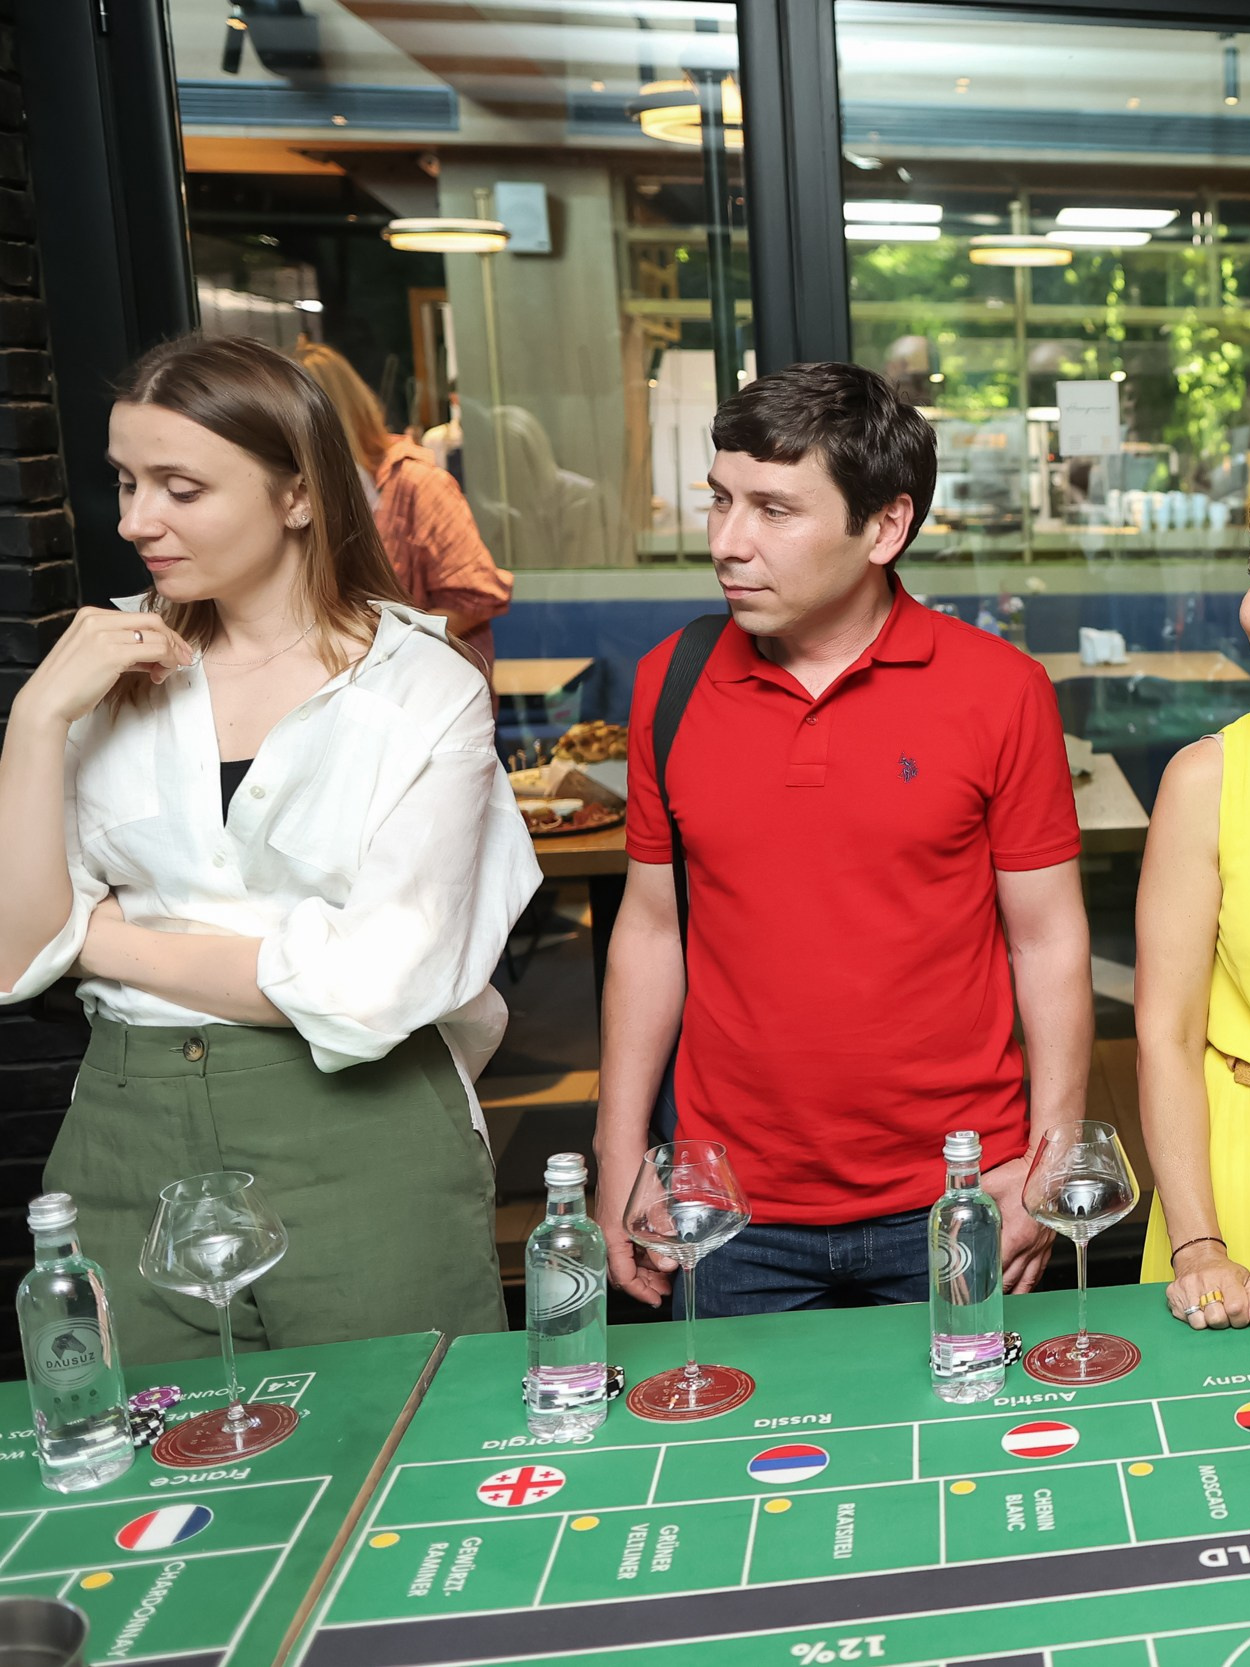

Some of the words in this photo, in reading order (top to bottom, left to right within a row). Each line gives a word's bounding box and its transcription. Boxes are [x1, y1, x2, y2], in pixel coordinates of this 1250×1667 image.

[46, 1352, 96, 1369] DAUSUZ
[267, 1379, 300, 1392] x4
[993, 1390, 1077, 1407] Austria
[753, 1413, 833, 1429] Russia
[150, 1467, 252, 1487] France
[1198, 1464, 1229, 1520] MOSCATO
[1005, 1493, 1026, 1532] BLANC
[1034, 1488, 1055, 1532] CHENIN
[617, 1522, 650, 1580] VELTLINER
[650, 1524, 681, 1573] GRÜNER
[833, 1502, 856, 1560] RKATSITELI
[407, 1542, 450, 1598] RAMINER
[106, 1560, 186, 1656] CHARDONNAY
[790, 1634, 886, 1666] 12%
